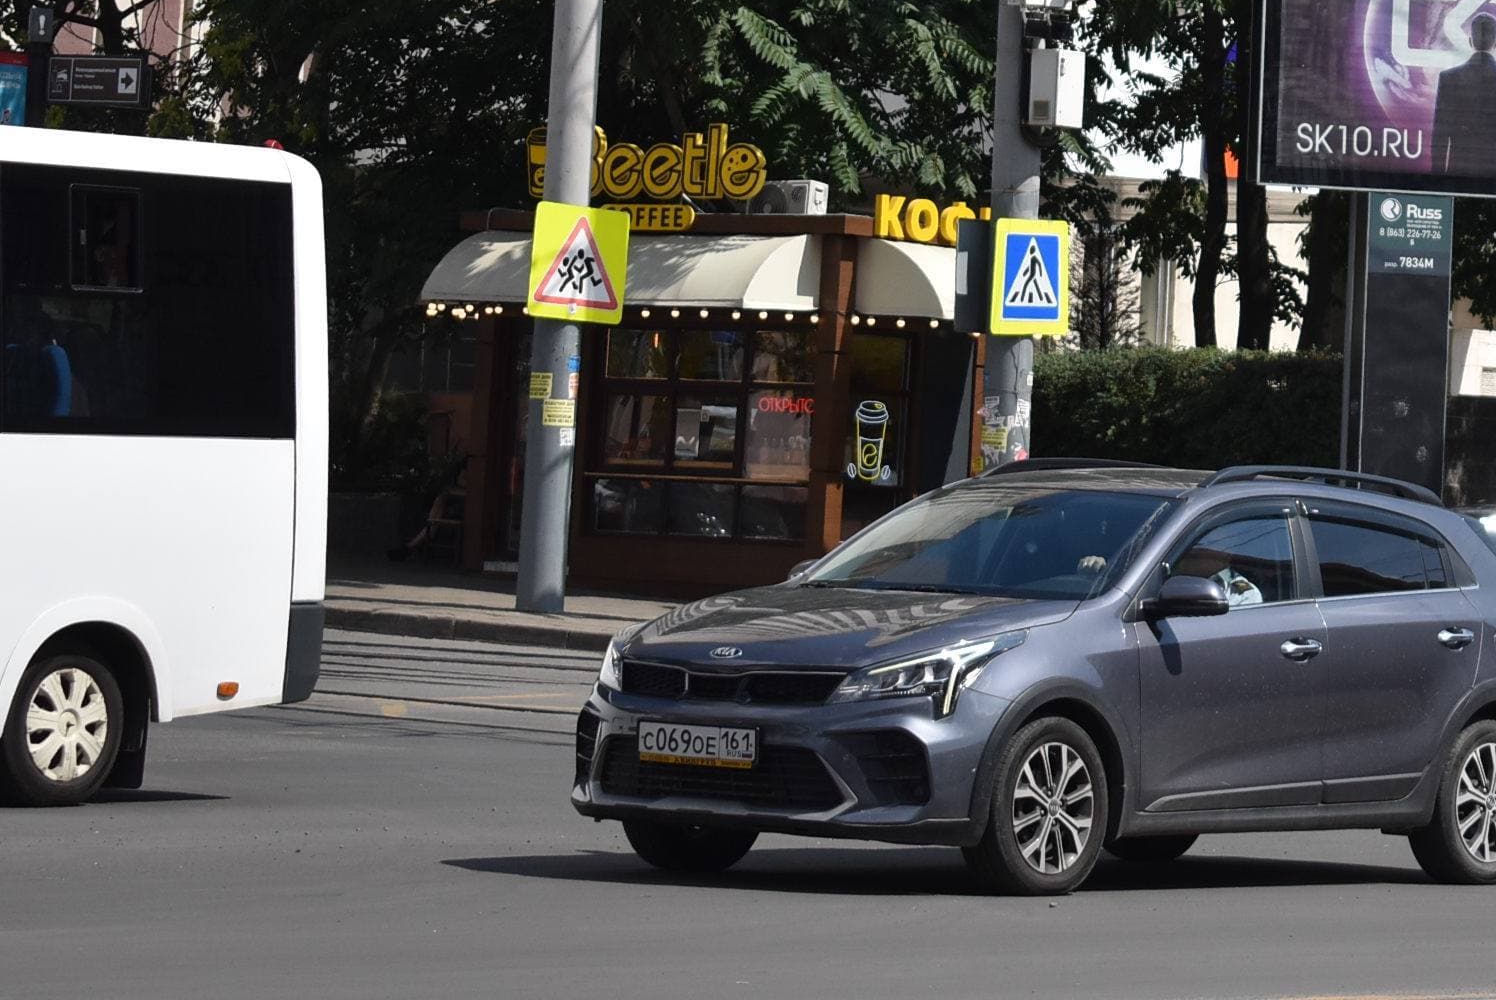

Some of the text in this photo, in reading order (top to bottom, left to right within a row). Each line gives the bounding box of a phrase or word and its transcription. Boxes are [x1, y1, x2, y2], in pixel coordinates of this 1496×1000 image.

[1296, 122, 1423, 159] SK10.RU
[605, 206, 684, 228] FFEE
[874, 193, 992, 247] КОФ
[1406, 203, 1443, 220] Russ
[1379, 226, 1442, 240] 8 (863) 226-77-26
[720, 730, 751, 751] 161
